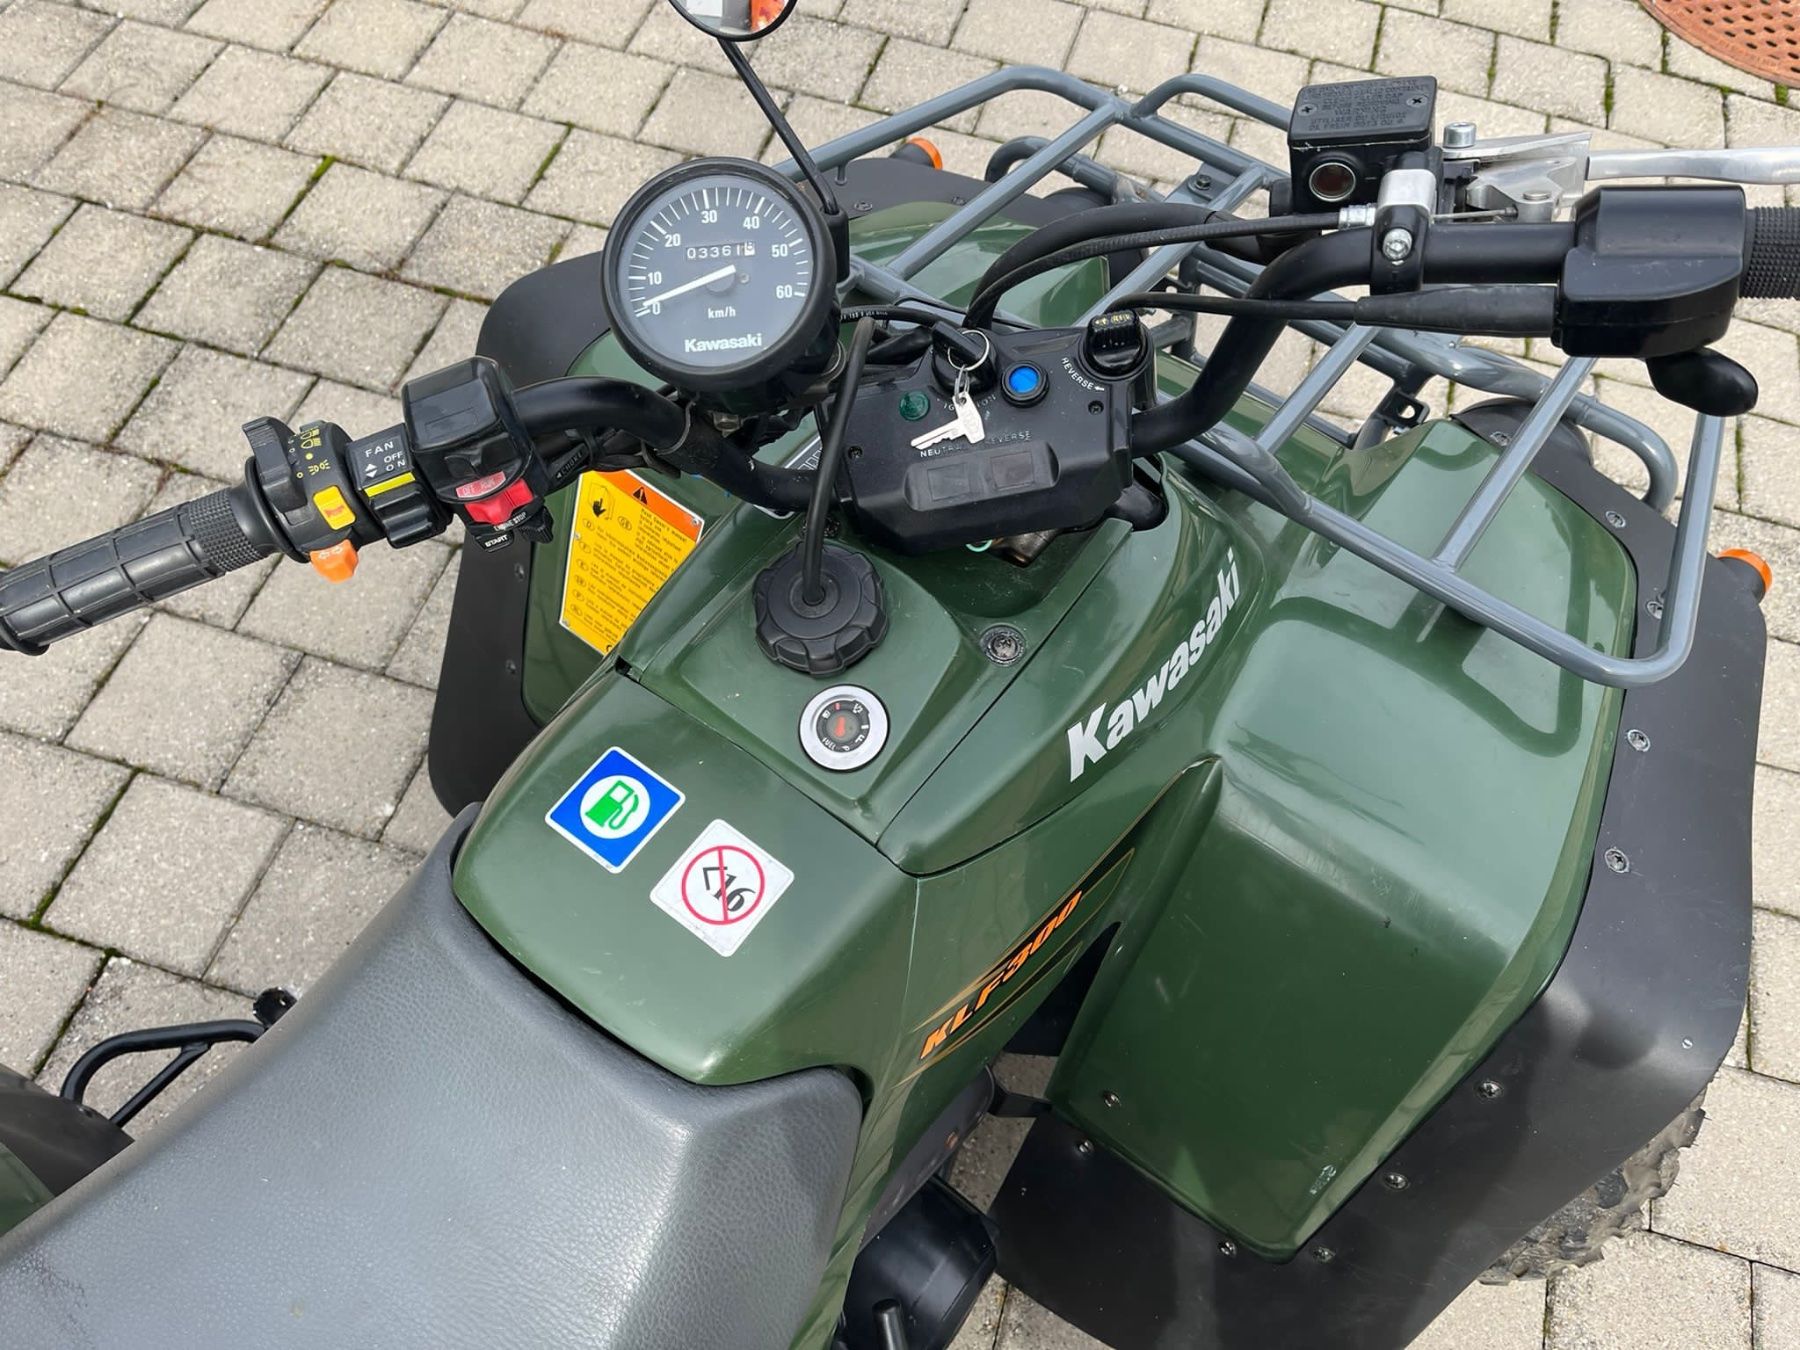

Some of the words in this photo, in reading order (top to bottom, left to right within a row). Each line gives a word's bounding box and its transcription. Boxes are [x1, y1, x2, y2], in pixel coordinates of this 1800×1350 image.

[701, 210, 718, 225] 30
[743, 216, 760, 230] 40
[664, 233, 681, 248] 20
[771, 244, 788, 257] 50
[647, 271, 662, 286] 10
[775, 285, 793, 299] 60
[652, 303, 661, 315] 0
[707, 307, 736, 319] km/h
[684, 332, 763, 353] Kawasaki
[1060, 356, 1095, 391] REVERSE
[365, 441, 394, 458] FAN
[383, 451, 404, 463] OFF
[386, 458, 406, 472] ON
[484, 534, 508, 548] START
[1067, 546, 1240, 783] Kawasaki
[920, 889, 1083, 1060] KLF300
